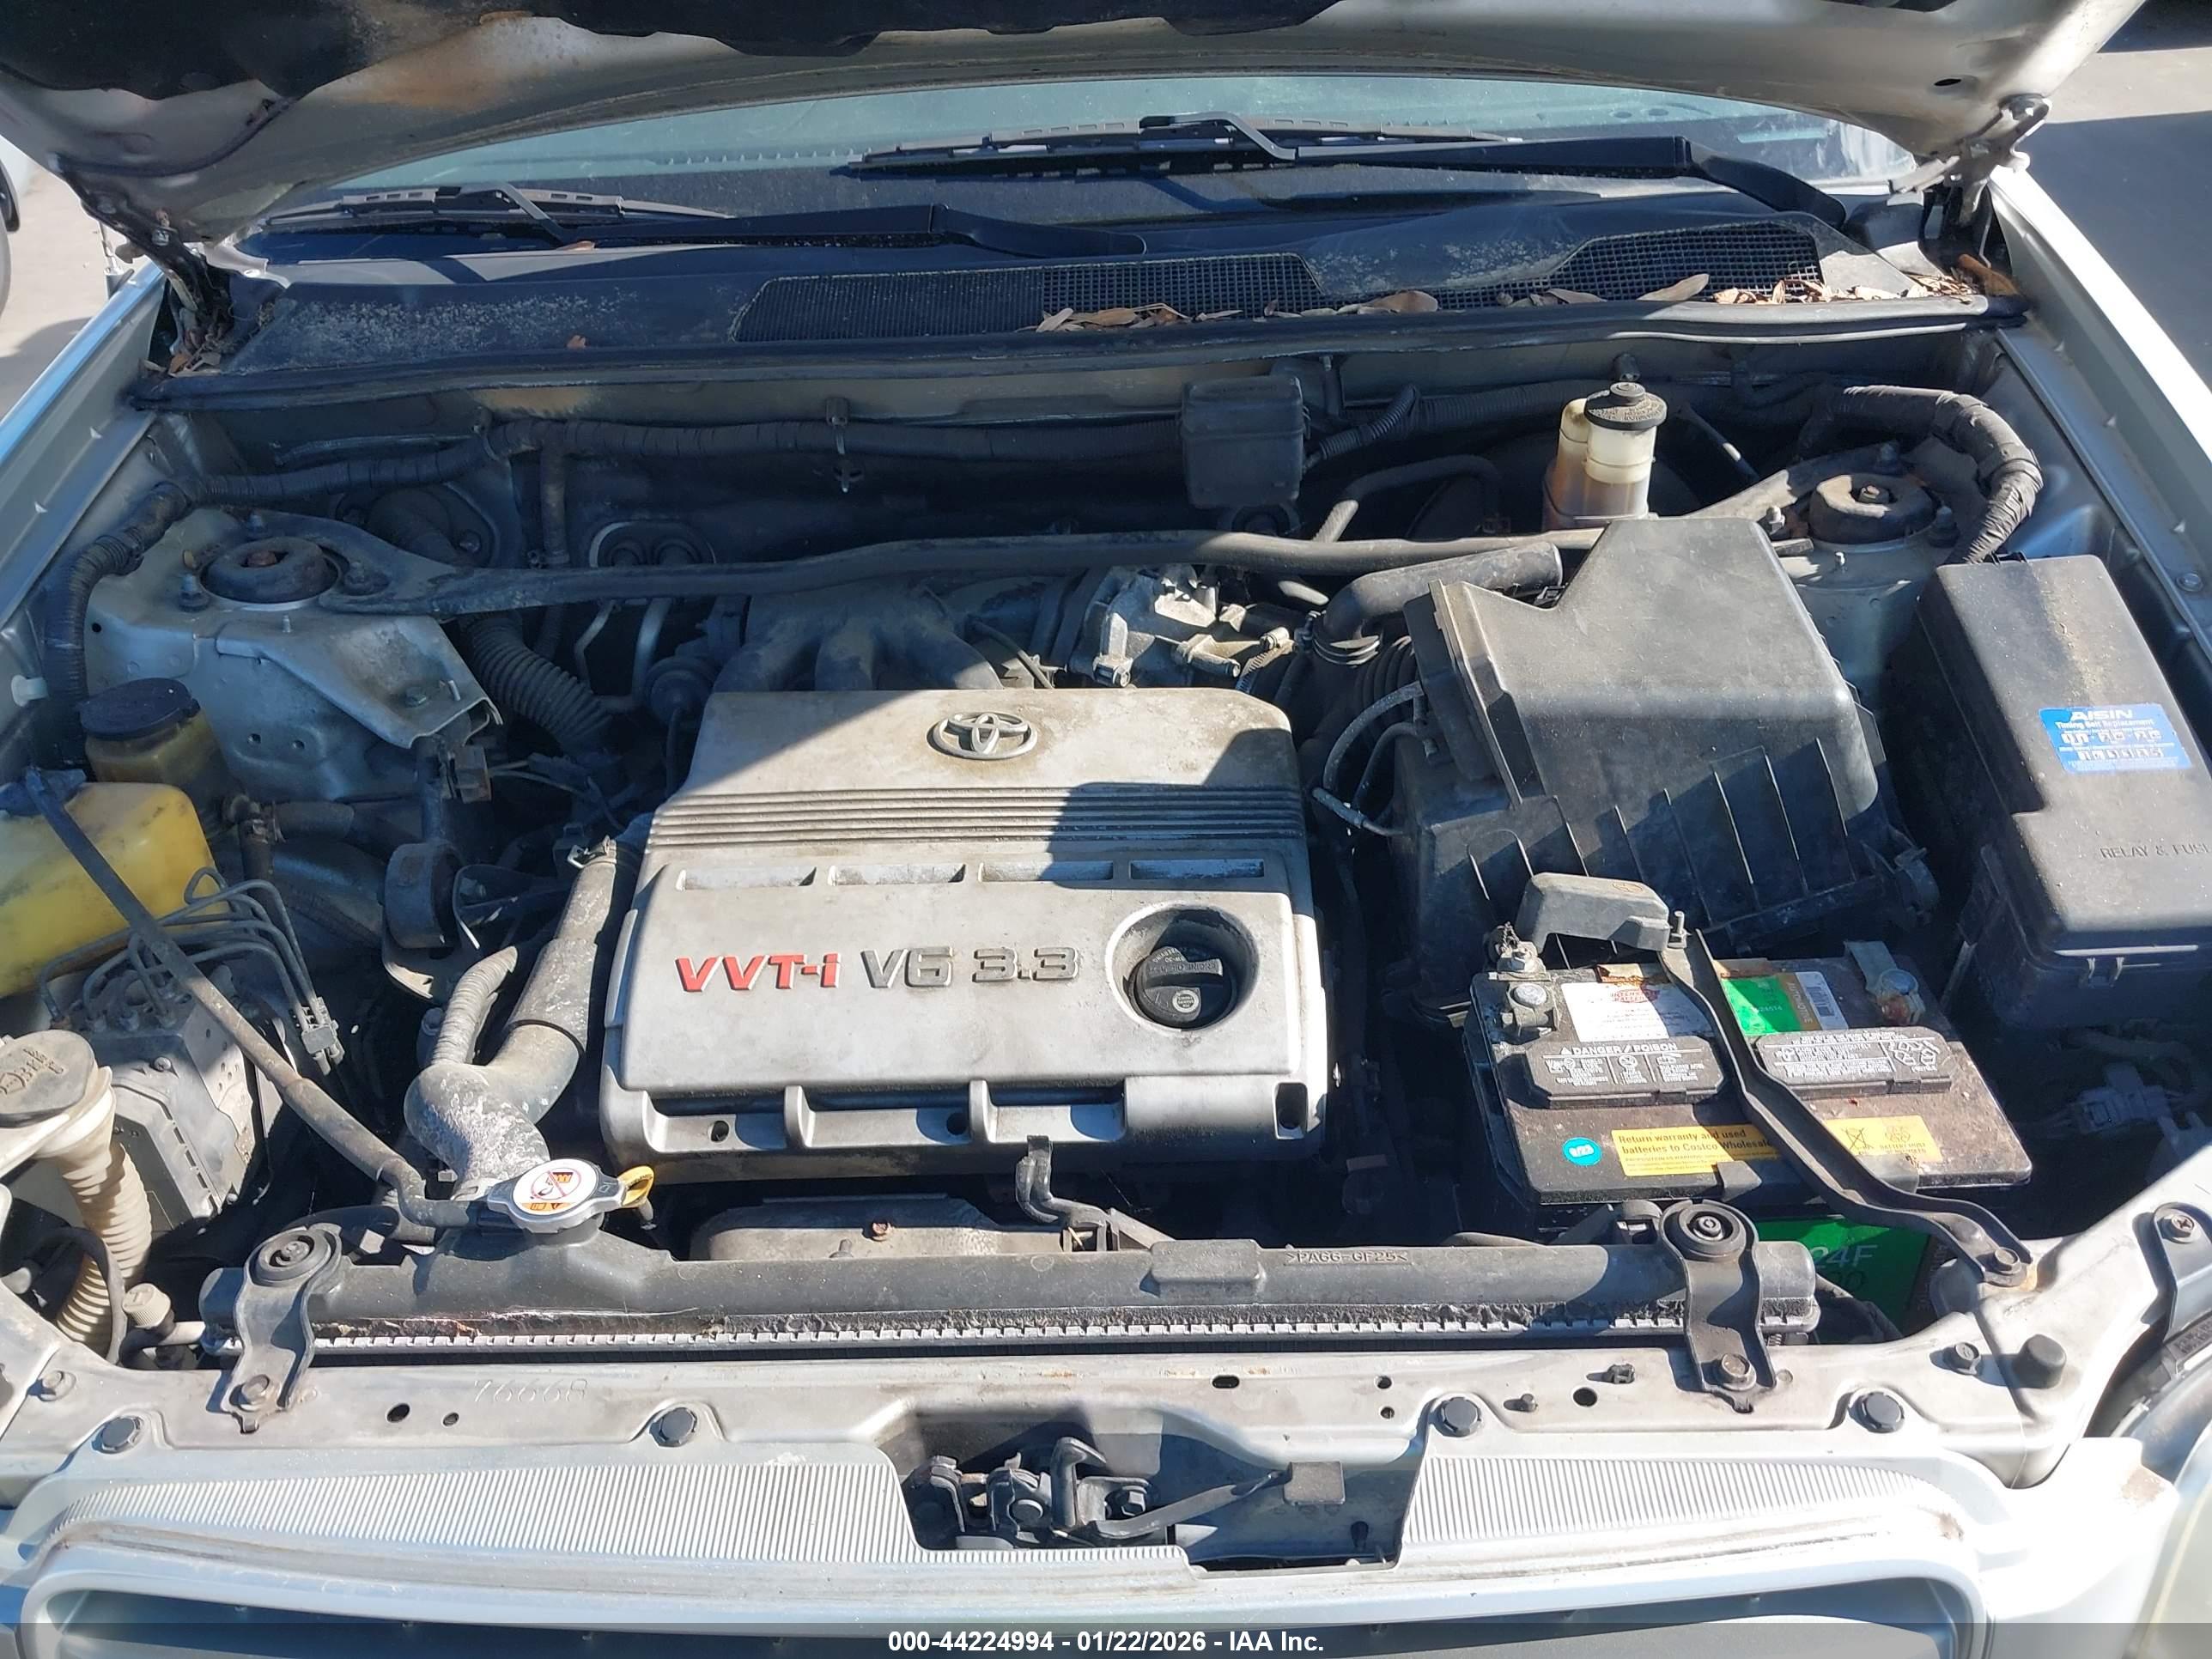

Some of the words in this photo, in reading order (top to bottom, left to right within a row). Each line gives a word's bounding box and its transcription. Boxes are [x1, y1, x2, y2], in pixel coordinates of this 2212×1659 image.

[2069, 709, 2133, 721] AISIN
[2100, 844, 2148, 859] RELAY
[2156, 844, 2169, 856] &
[675, 952, 842, 993] VVT-i
[860, 945, 955, 989] V6
[971, 946, 1081, 984] 3.3
[1571, 1045, 1622, 1055] DANGER
[1632, 1042, 1677, 1053] POISON
[1619, 1134, 1653, 1143] Return
[1654, 1132, 1698, 1143] warranty
[1701, 1130, 1718, 1139] and
[1721, 1128, 1747, 1138] used
[1622, 1144, 1668, 1154] batteries
[1668, 1143, 1680, 1152] to
[1683, 1141, 1718, 1152] Costco
[1810, 1244, 1878, 1268] 24F
